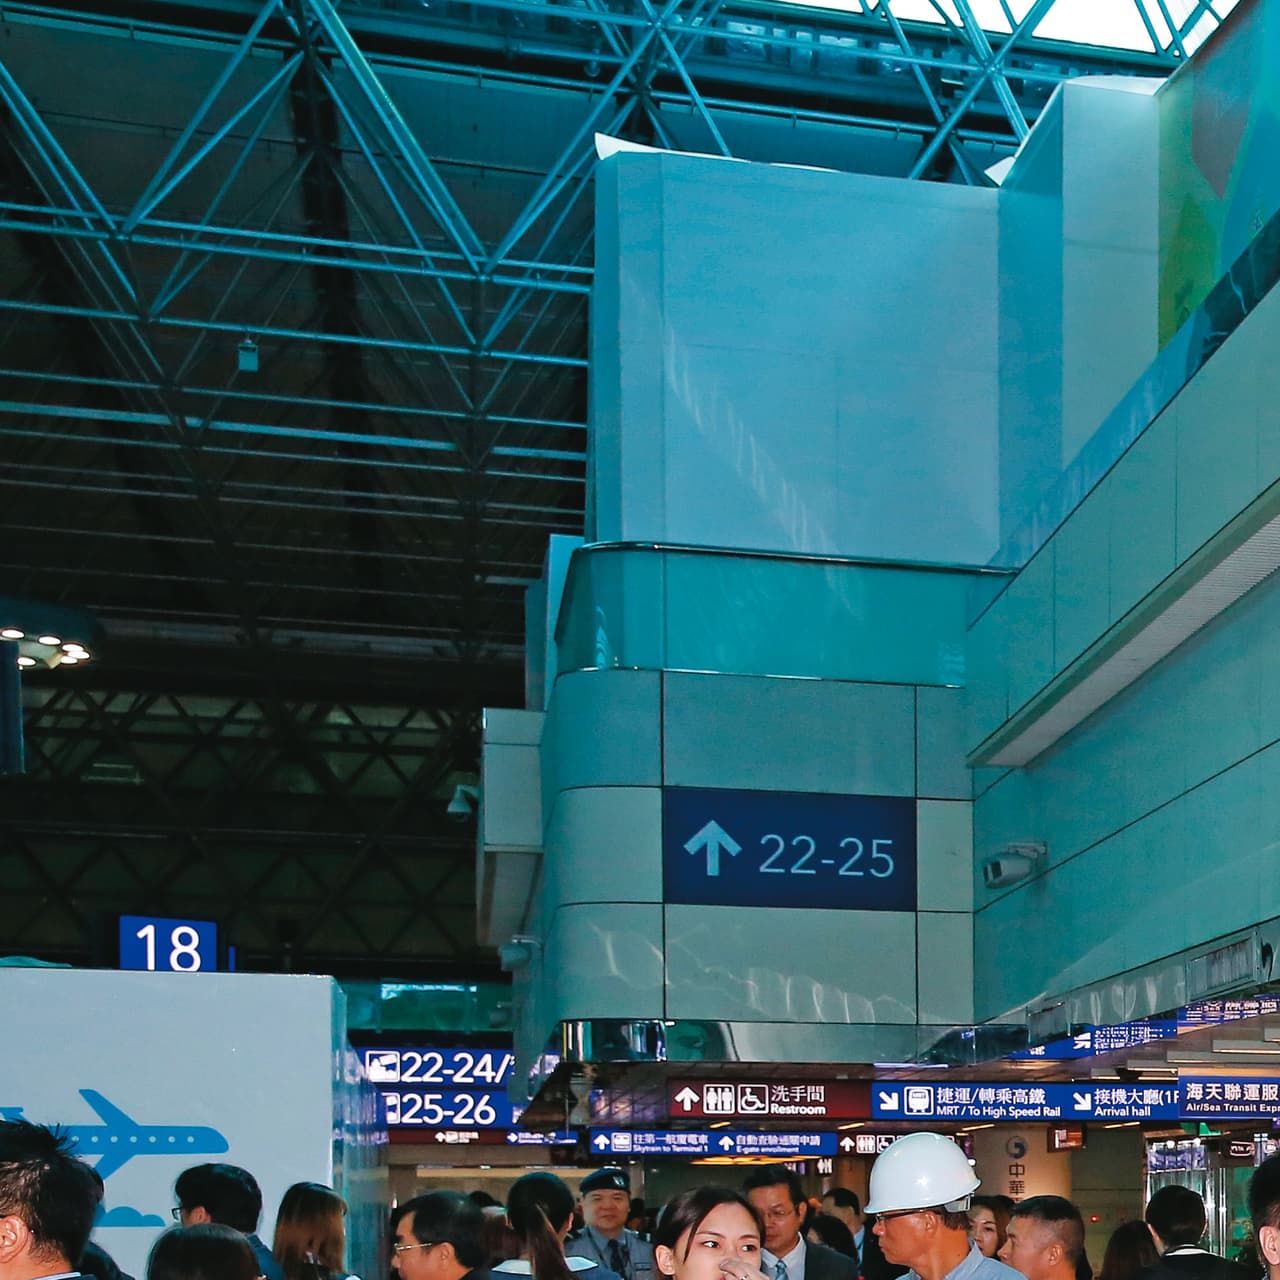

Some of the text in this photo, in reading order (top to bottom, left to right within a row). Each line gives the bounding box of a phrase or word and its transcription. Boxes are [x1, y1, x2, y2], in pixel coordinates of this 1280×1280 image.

[758, 833, 896, 878] 22-25
[135, 925, 202, 972] 18
[400, 1052, 516, 1084] 22-24/
[771, 1085, 825, 1103] 洗手間
[936, 1086, 1046, 1105] 捷運/轉乘高鐵
[400, 1093, 497, 1126] 25-26
[770, 1103, 826, 1116] Restroom
[936, 1106, 960, 1116] MRT
[967, 1106, 981, 1116] To
[983, 1106, 1007, 1118] High
[1008, 1106, 1042, 1118] Speed
[1043, 1106, 1061, 1117] Rail
[1094, 1106, 1151, 1117] Arrival hall
[1186, 1103, 1221, 1112] Air/Sea
[1223, 1103, 1257, 1112] Transit
[1008, 1162, 1026, 1201] 中華
